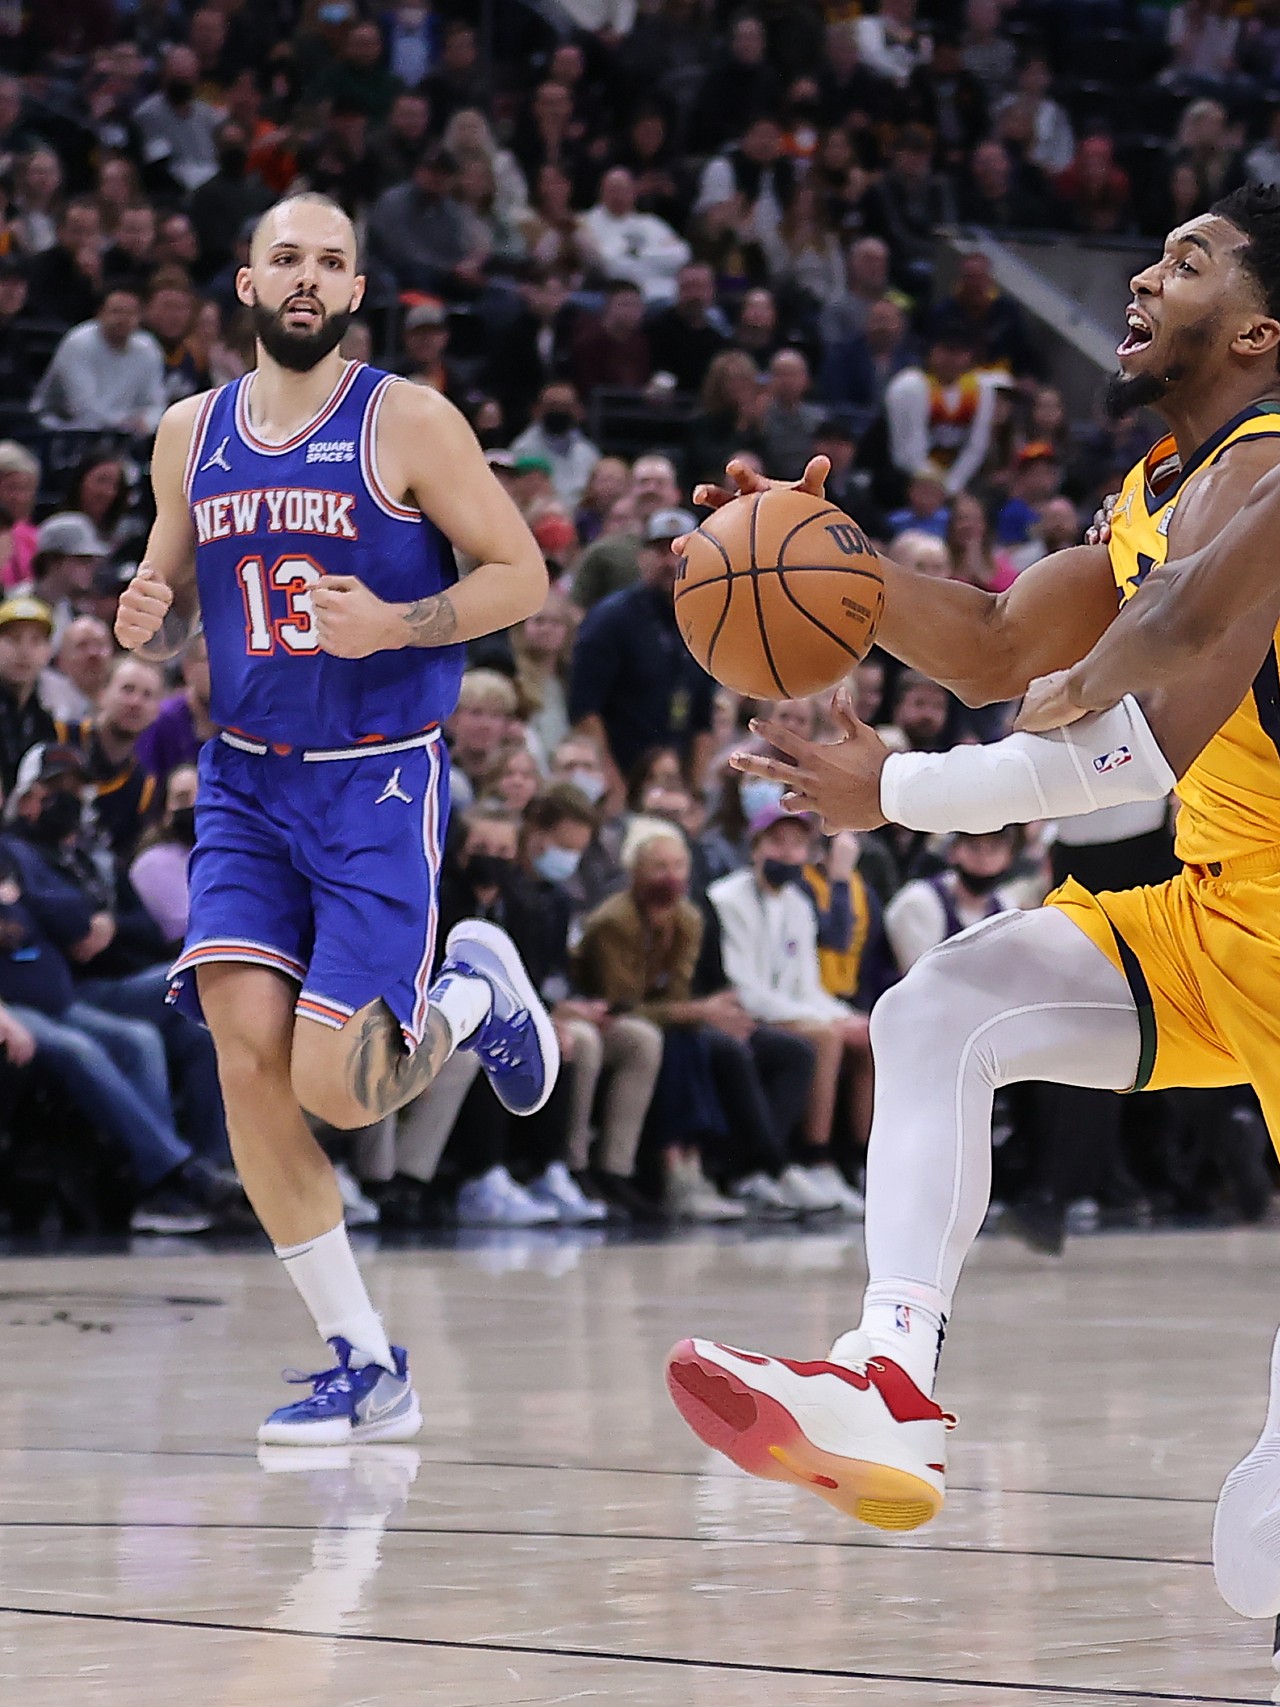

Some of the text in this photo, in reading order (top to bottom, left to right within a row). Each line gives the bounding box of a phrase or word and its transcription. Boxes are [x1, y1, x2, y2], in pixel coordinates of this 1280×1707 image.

[305, 452, 344, 464] SPACE
[307, 441, 355, 453] SQUARE
[191, 486, 359, 546] NEW YORK
[235, 554, 327, 656] 13
